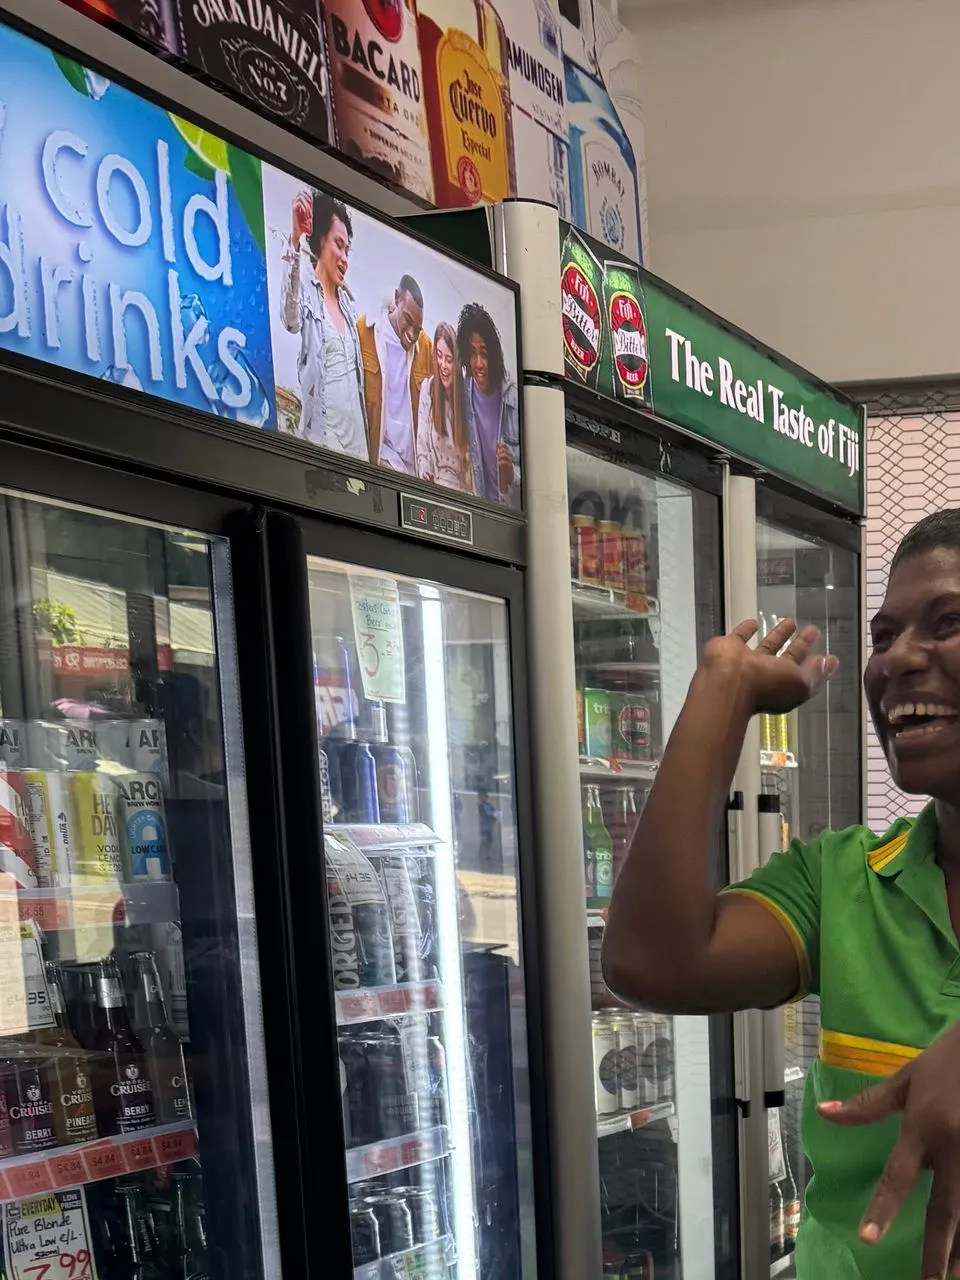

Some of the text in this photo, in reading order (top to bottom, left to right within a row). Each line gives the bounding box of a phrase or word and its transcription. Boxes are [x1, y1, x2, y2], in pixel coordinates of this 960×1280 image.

[507, 37, 565, 107] AMUNDSEN
[449, 79, 498, 139] Cuervo
[41, 131, 234, 287] cold
[0, 207, 252, 407] drinks
[565, 294, 597, 343] Bitter
[665, 327, 860, 477] The Real Taste of Fiji
[60, 1092, 93, 1107] CRUIS
[124, 1104, 150, 1116] BERRY
[25, 1127, 52, 1140] BERRY
[21, 1197, 58, 1217] EVERYDAY
[62, 1193, 78, 1202] LOW
[9, 1213, 72, 1238] Pure Blonde
[40, 1235, 57, 1247] Low
